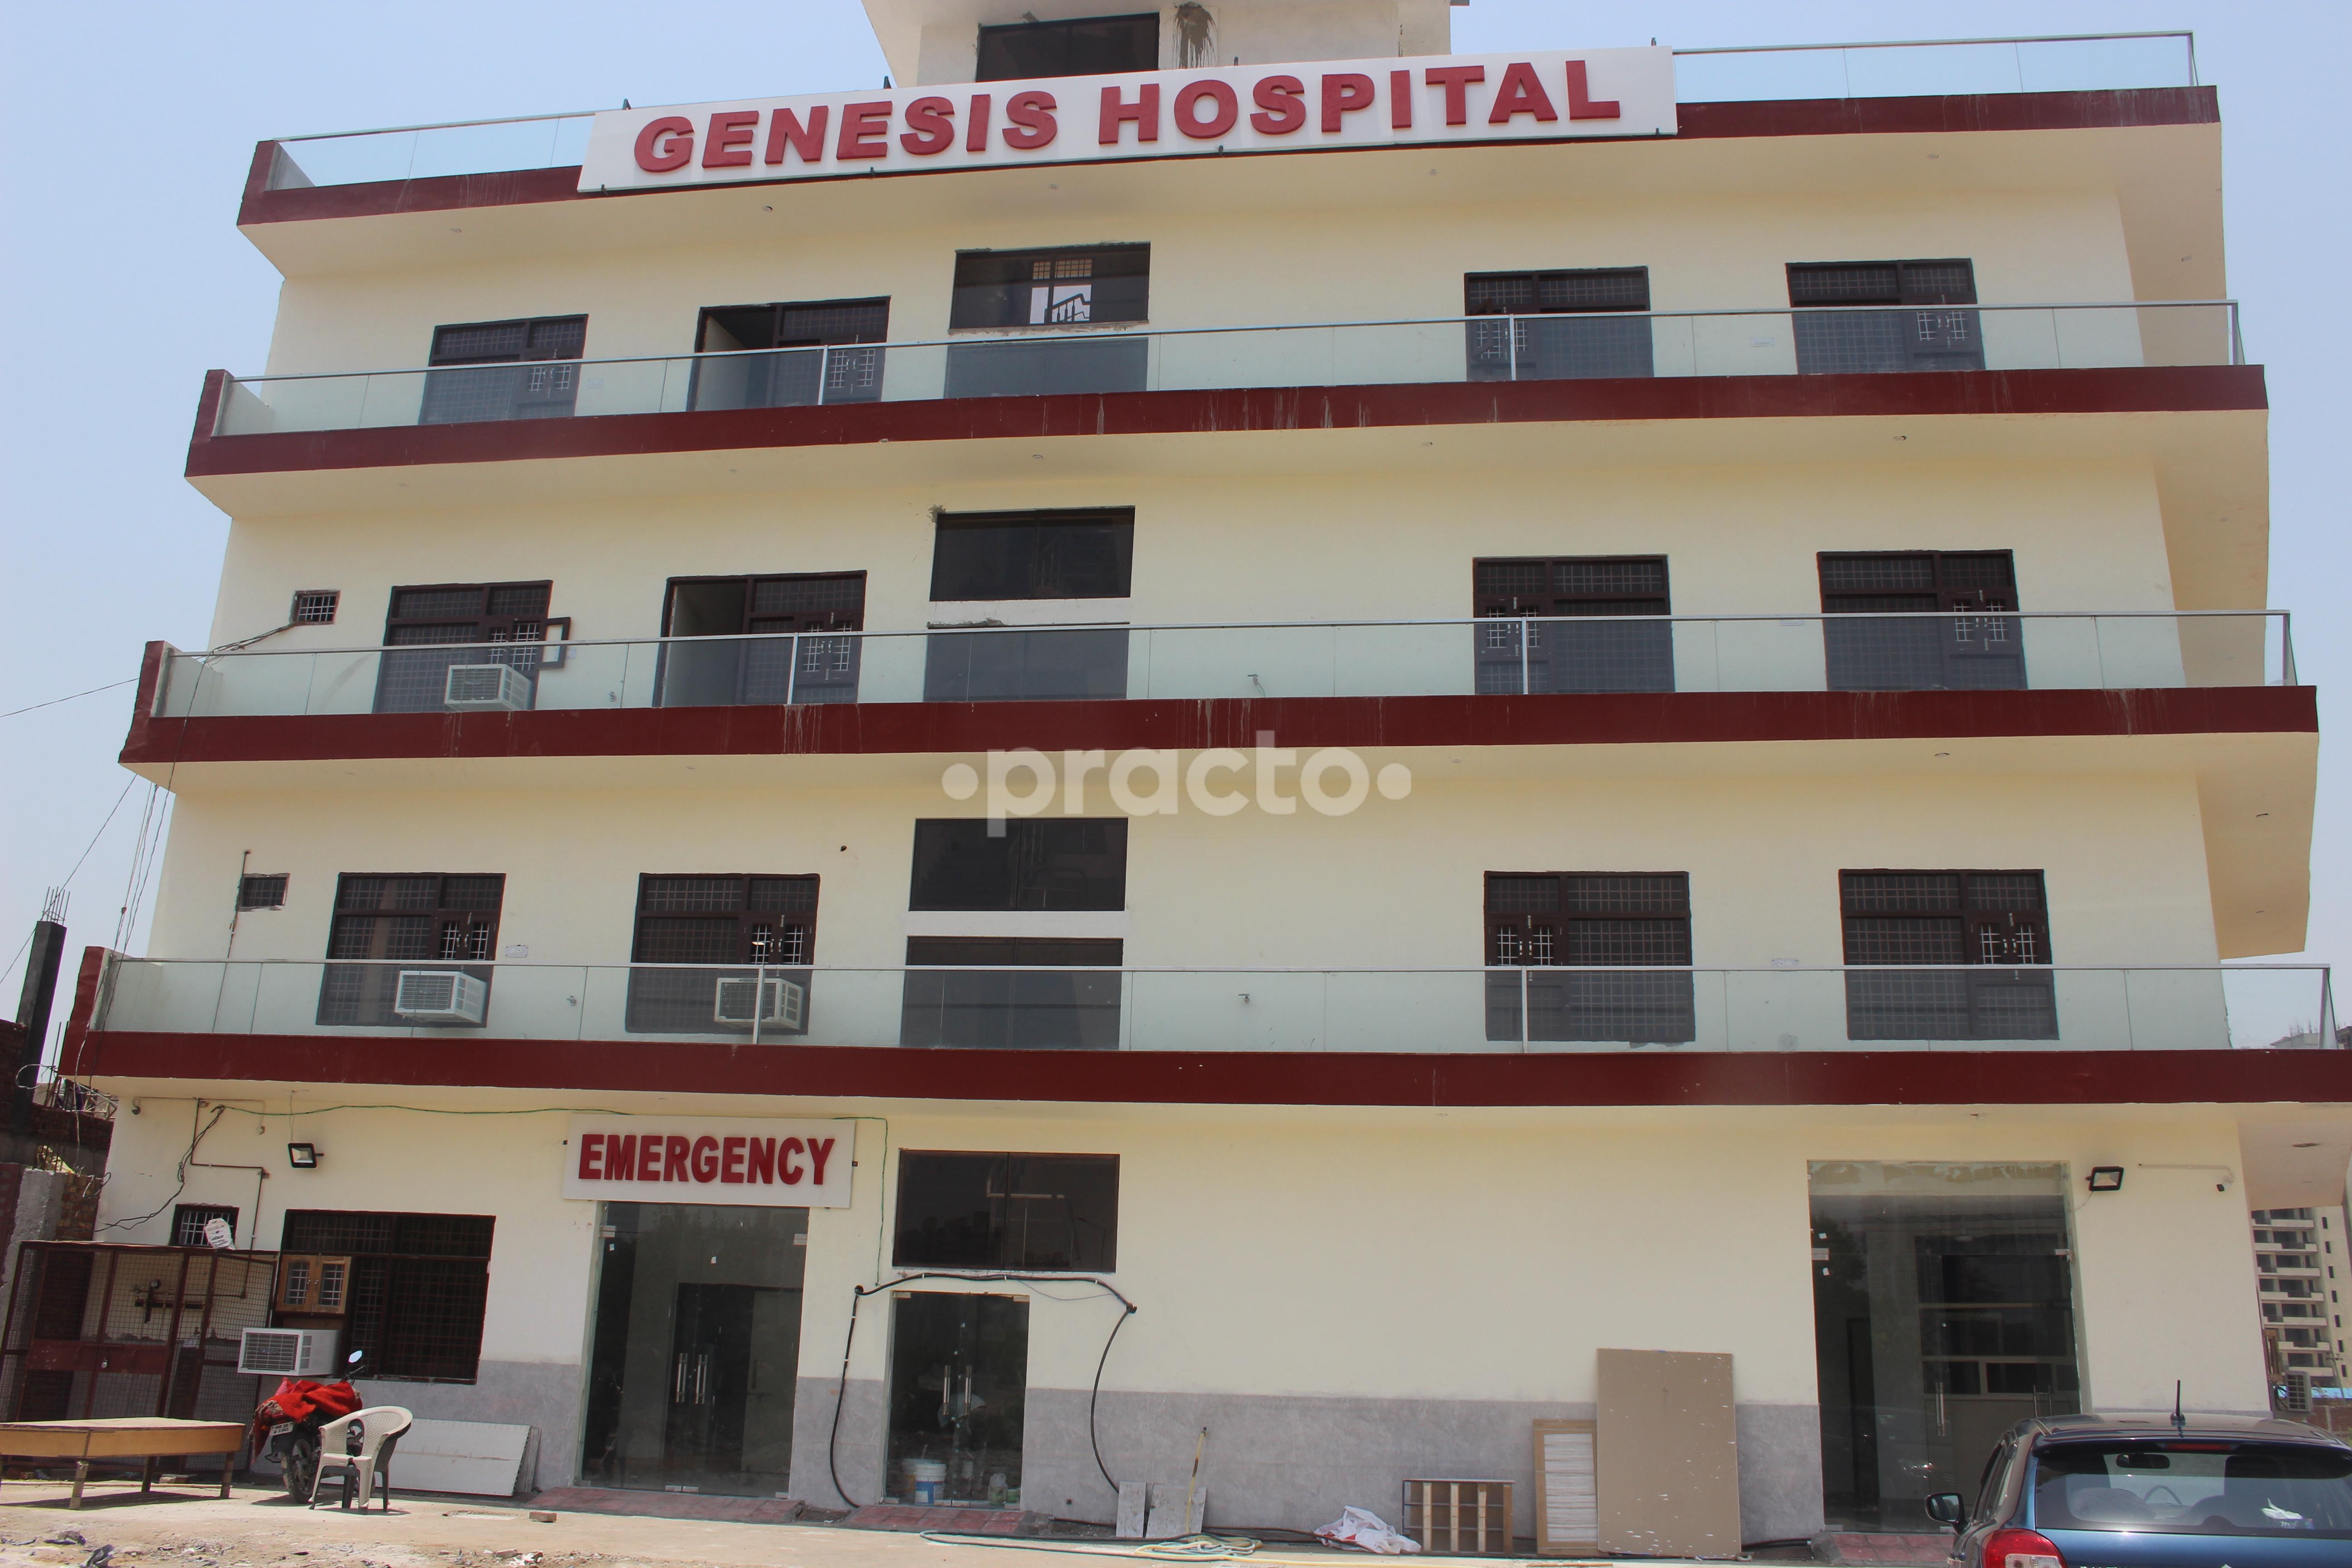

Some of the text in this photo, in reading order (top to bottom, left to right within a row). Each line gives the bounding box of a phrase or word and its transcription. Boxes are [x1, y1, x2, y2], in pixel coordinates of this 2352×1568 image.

[635, 60, 1621, 174] GENESIS HOSPITAL
[578, 1133, 835, 1186] EMERGENCY
